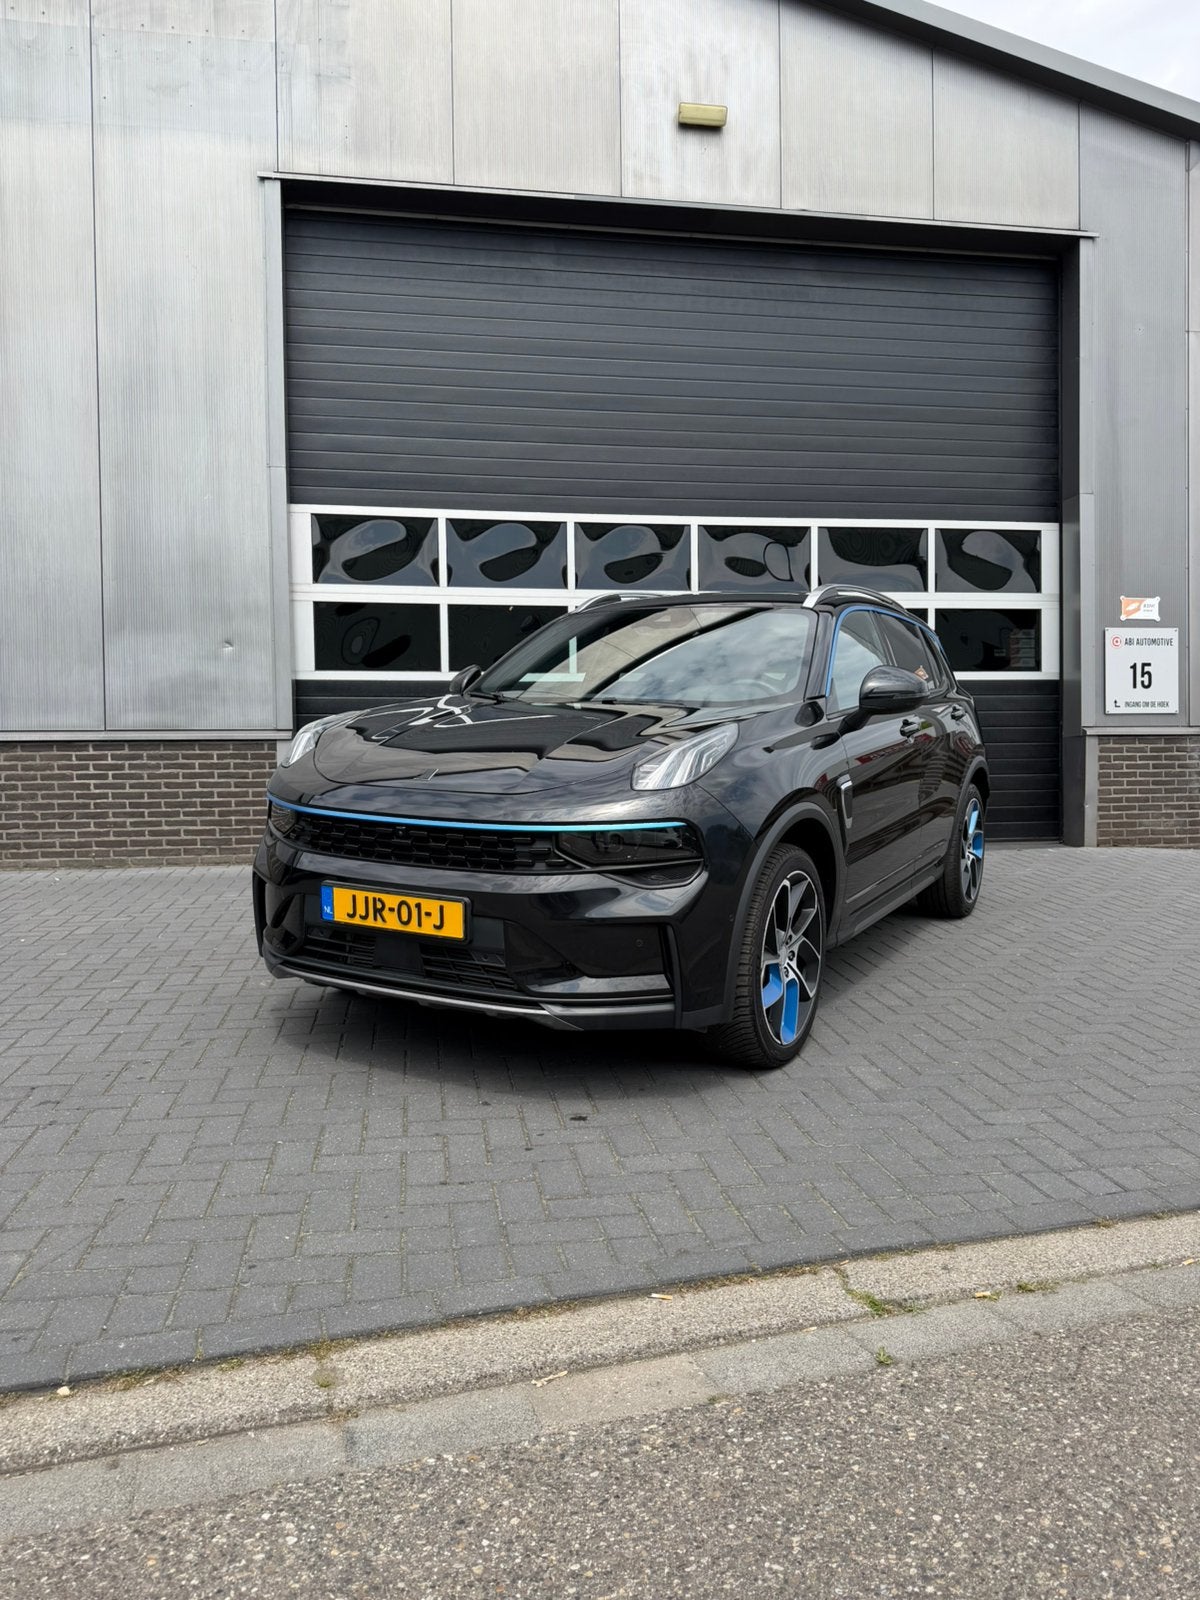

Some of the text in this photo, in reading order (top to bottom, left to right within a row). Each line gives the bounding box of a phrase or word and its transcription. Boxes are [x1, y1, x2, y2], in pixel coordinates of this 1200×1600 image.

[1124, 637, 1174, 646] ABI AUTOMOTIVE
[1130, 662, 1152, 689] 15
[323, 906, 333, 914] NL
[346, 894, 445, 930] JJR-01-J
